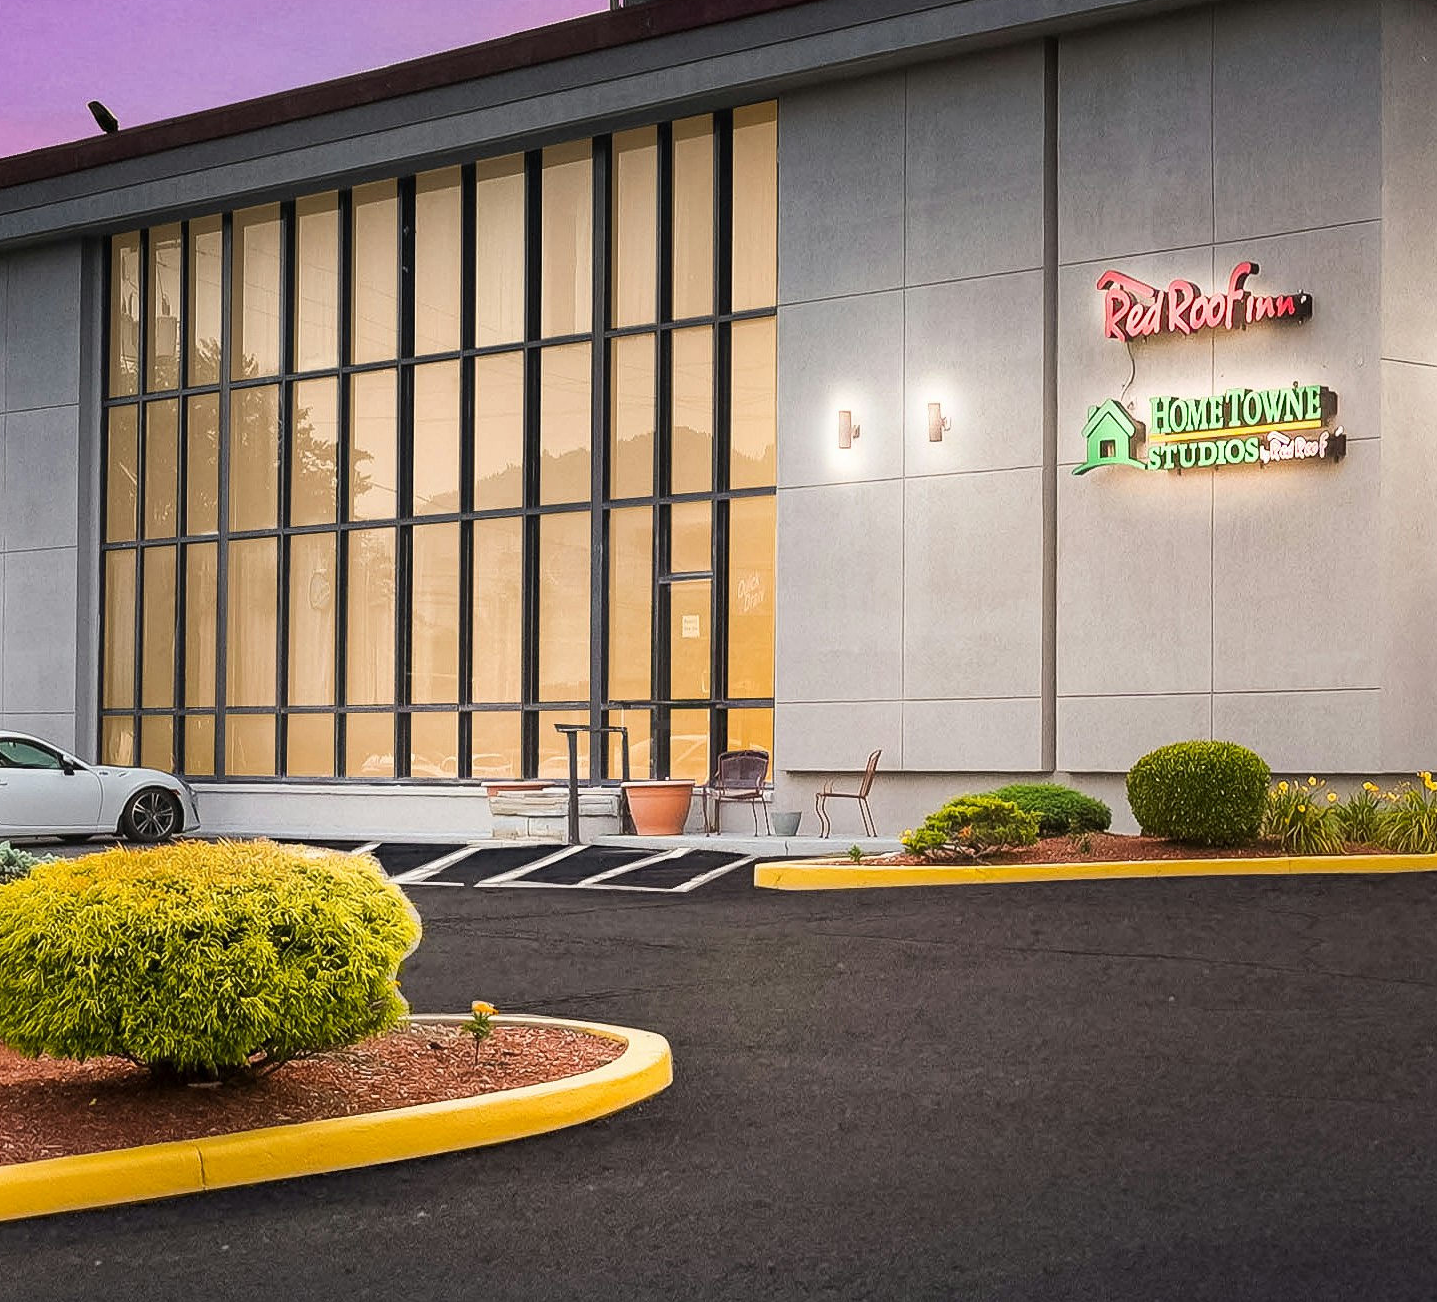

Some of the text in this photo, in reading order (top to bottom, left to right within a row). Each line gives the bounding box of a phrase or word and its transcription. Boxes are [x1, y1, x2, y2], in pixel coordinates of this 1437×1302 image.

[1104, 287, 1162, 342] Red
[1168, 262, 1254, 335] Roof
[1147, 436, 1260, 471] STUDIOS
[1269, 438, 1294, 462] Red
[1294, 431, 1330, 460] Roof
